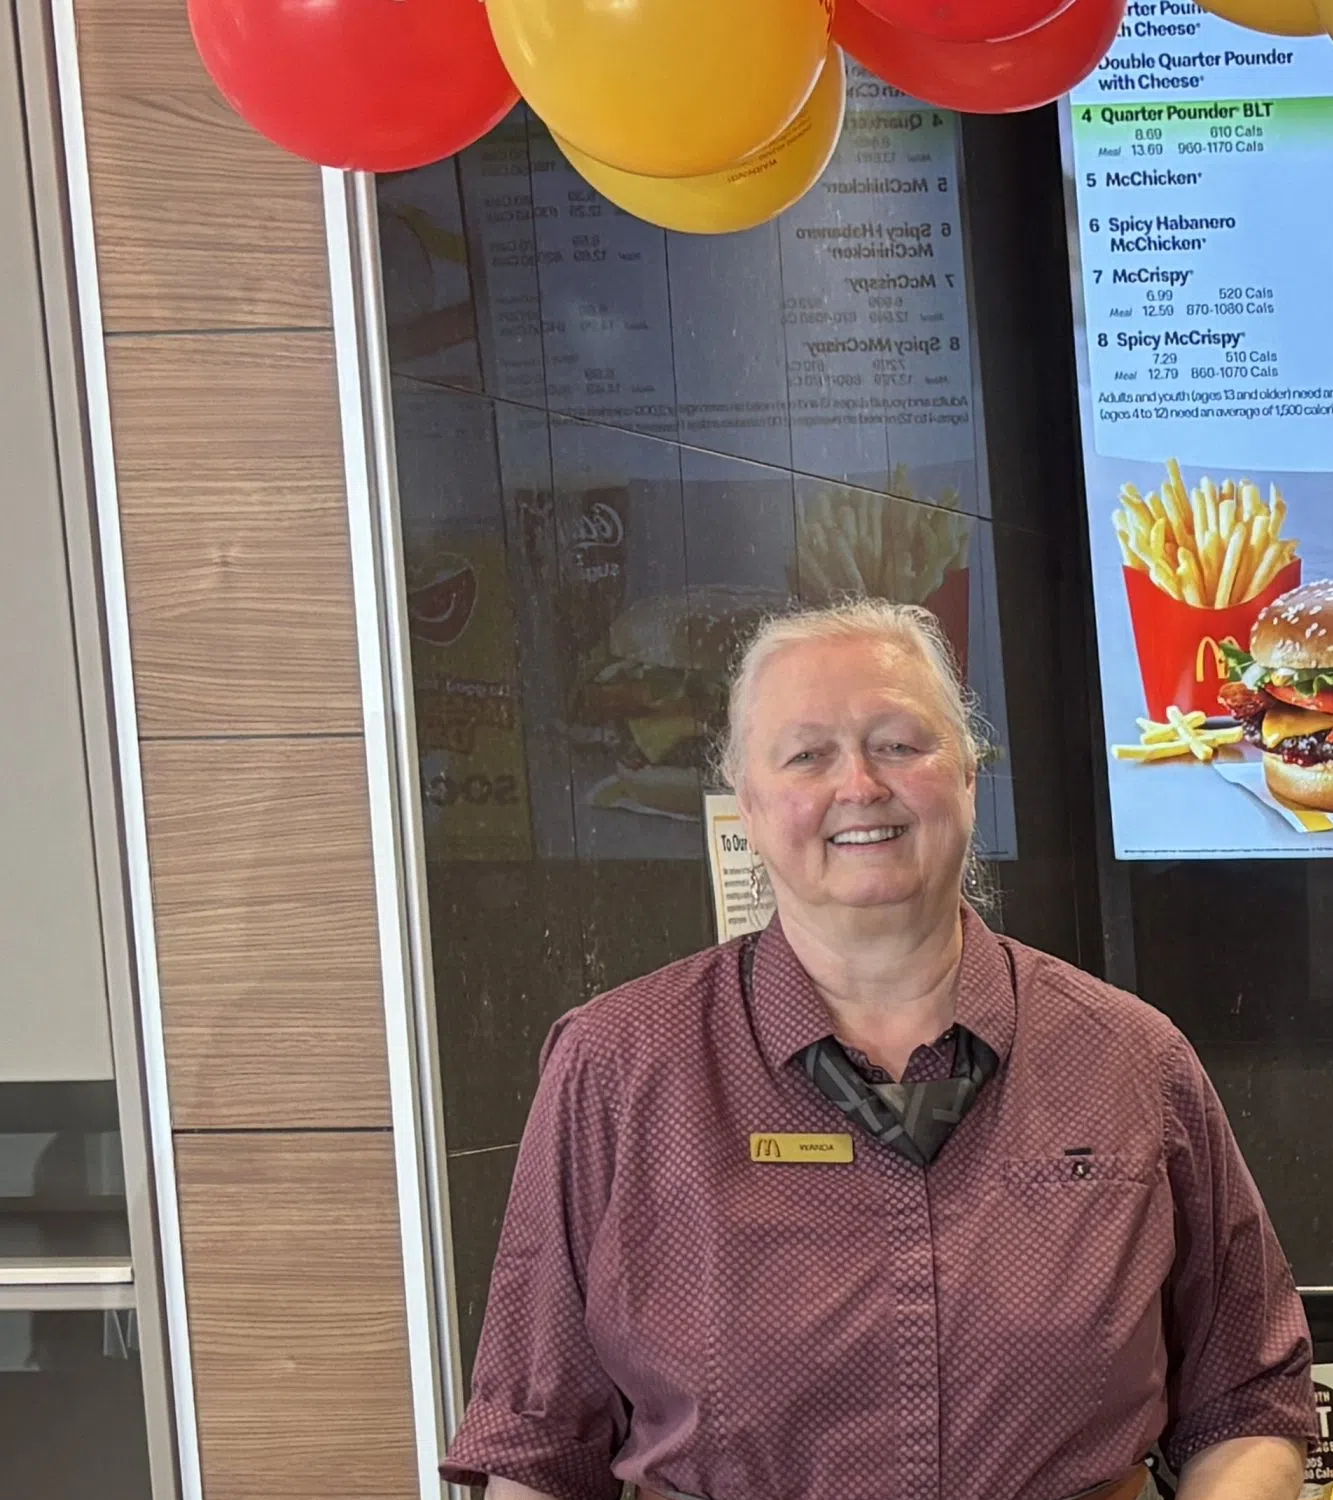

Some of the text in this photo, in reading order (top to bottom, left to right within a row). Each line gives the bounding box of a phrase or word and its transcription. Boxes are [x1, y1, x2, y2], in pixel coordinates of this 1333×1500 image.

[1159, 53, 1220, 69] Quarter
[1224, 49, 1293, 66] Pounder
[1099, 75, 1135, 91] with
[1082, 109, 1092, 123] 4
[1101, 107, 1163, 123] Quarter
[1243, 102, 1274, 118] BLT
[1235, 125, 1263, 138] Cals
[1235, 140, 1264, 153] Cals
[1086, 173, 1096, 187] 5
[1089, 215, 1236, 235] 6 Spicy Habanero
[1093, 270, 1103, 284] 7
[1219, 288, 1242, 300] 520
[1246, 287, 1274, 299] Cals
[1247, 302, 1275, 314] Cals
[1098, 333, 1108, 347] 8
[1117, 331, 1160, 350] Spicy
[1226, 351, 1247, 363] 510
[1250, 350, 1278, 362] Cals
[1250, 365, 1279, 377] Cals
[721, 835, 731, 851] To
